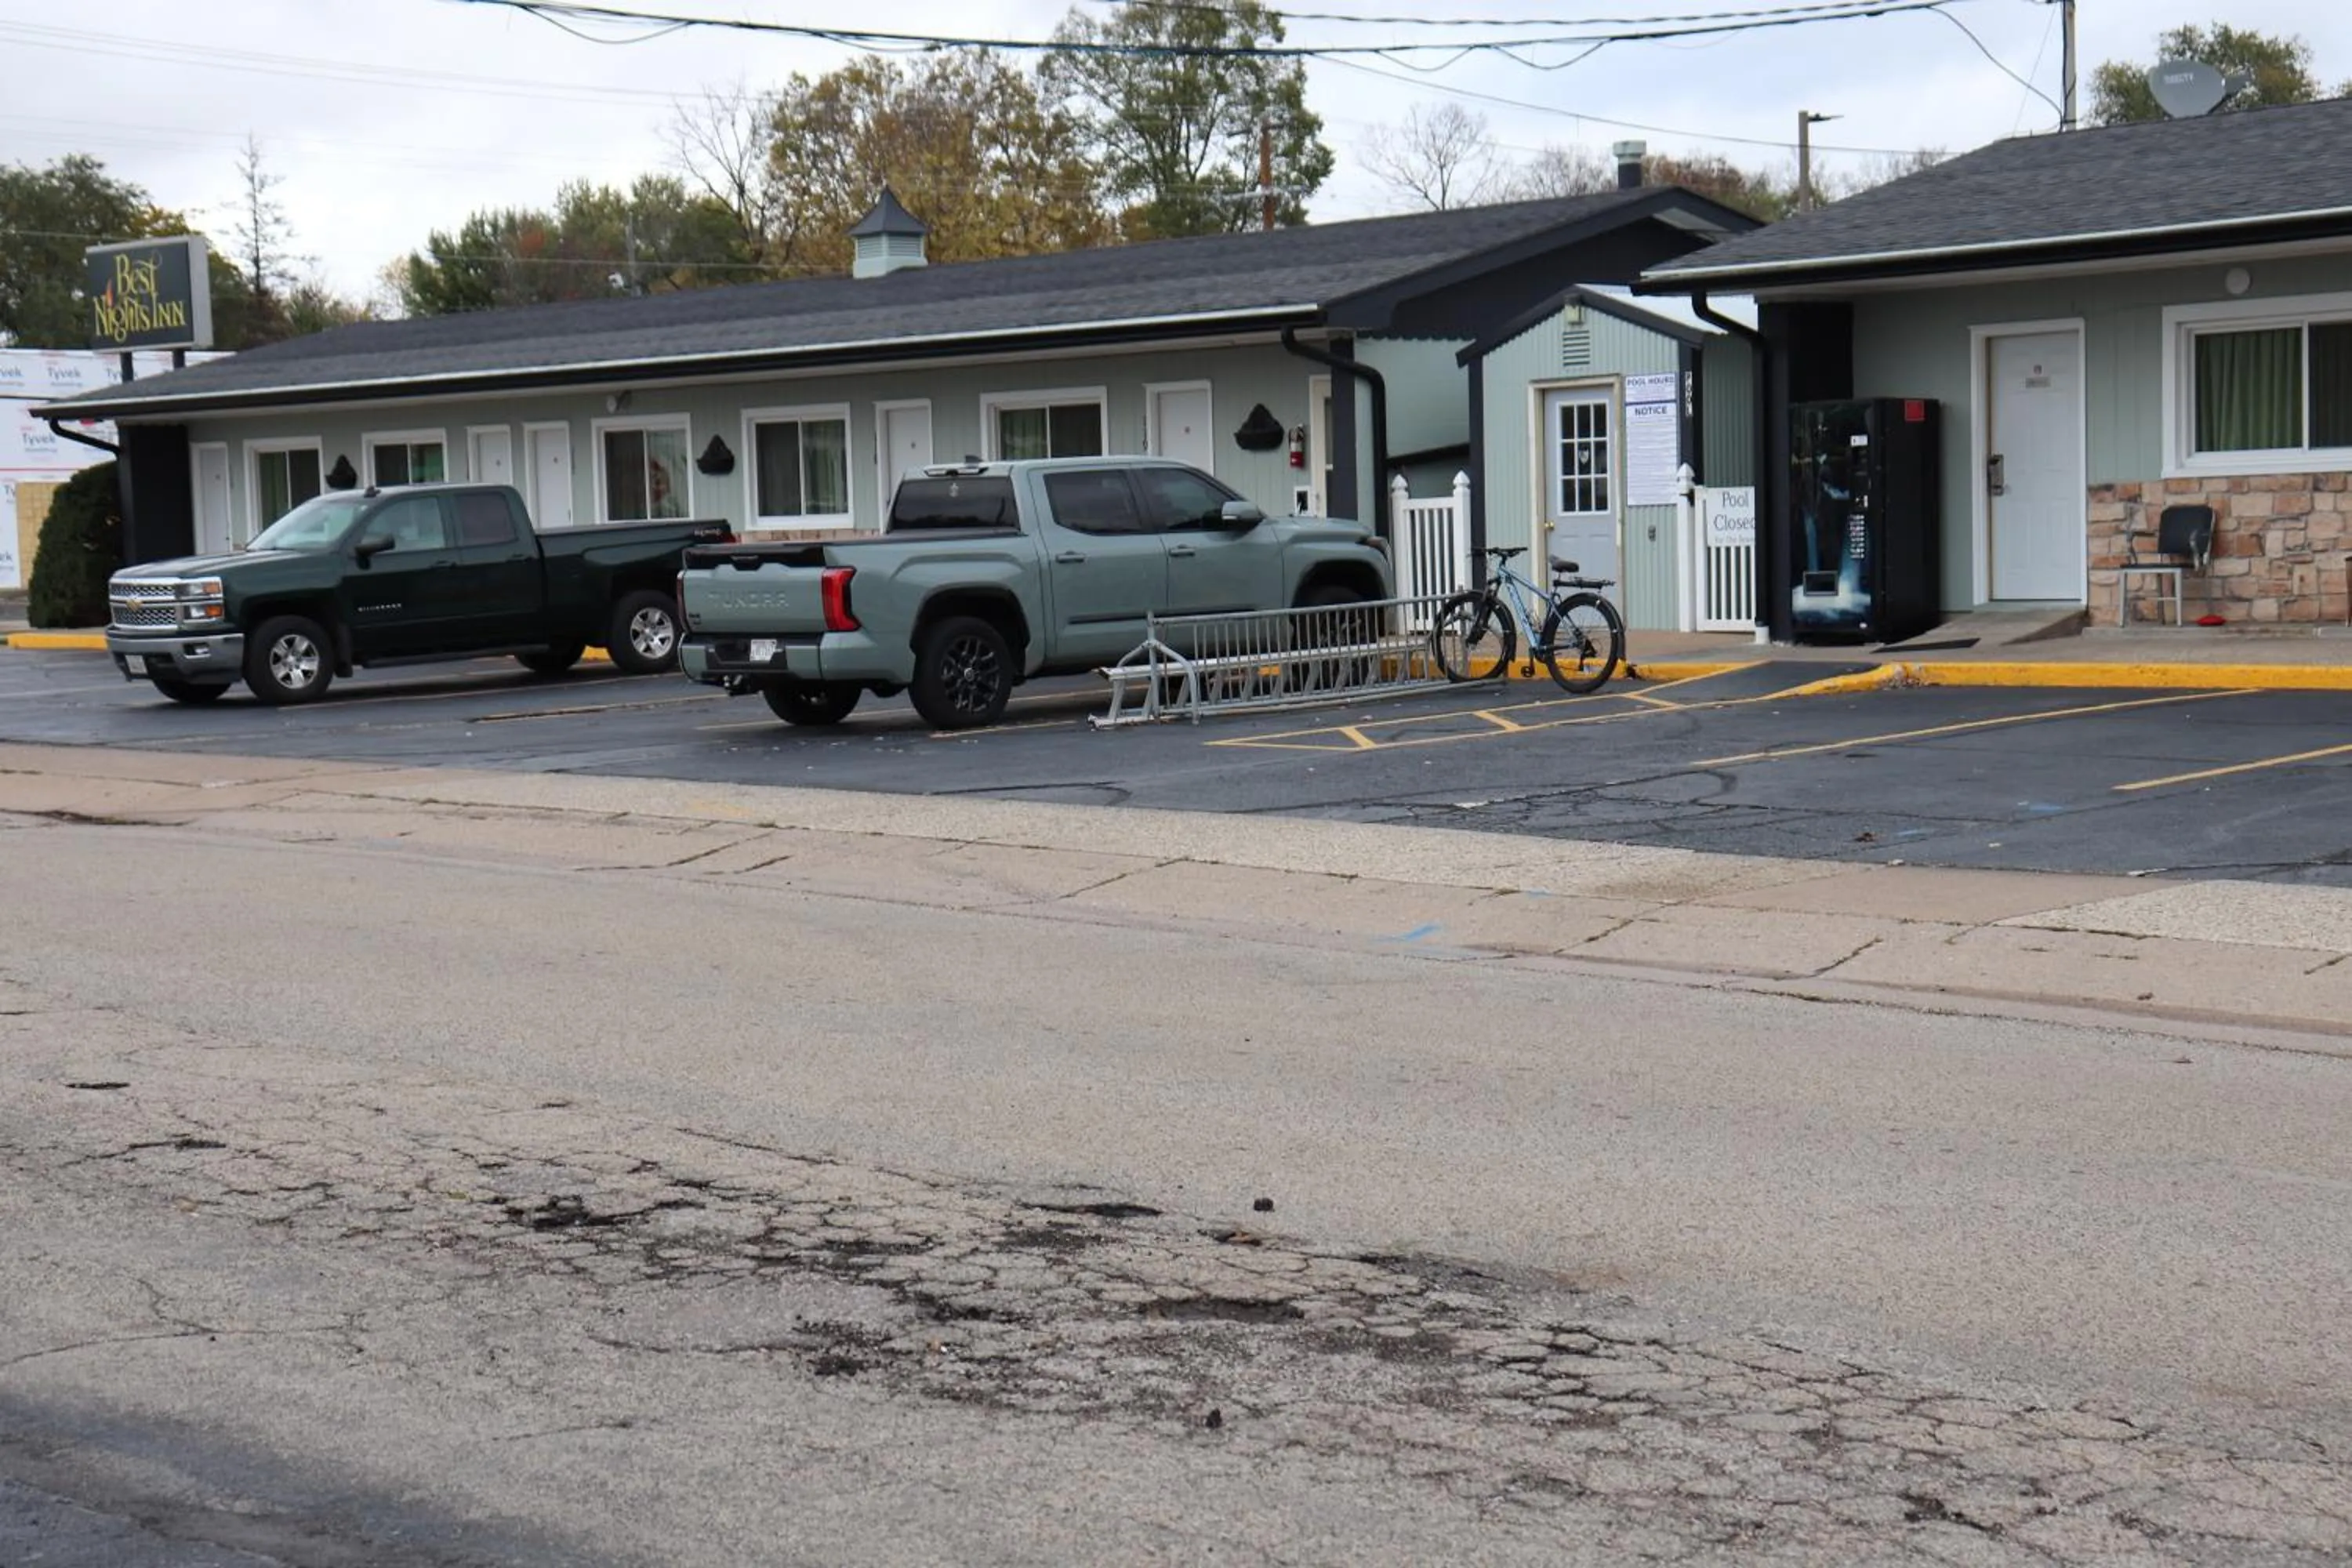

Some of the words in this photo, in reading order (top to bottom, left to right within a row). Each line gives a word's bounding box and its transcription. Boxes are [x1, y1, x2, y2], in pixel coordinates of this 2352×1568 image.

[115, 249, 162, 296] Best
[93, 294, 151, 343] Nights
[48, 367, 81, 379] Tyvek
[1635, 406, 1667, 416] NOTICE
[22, 433, 56, 445] Tyvek
[1722, 491, 1749, 507] Pool
